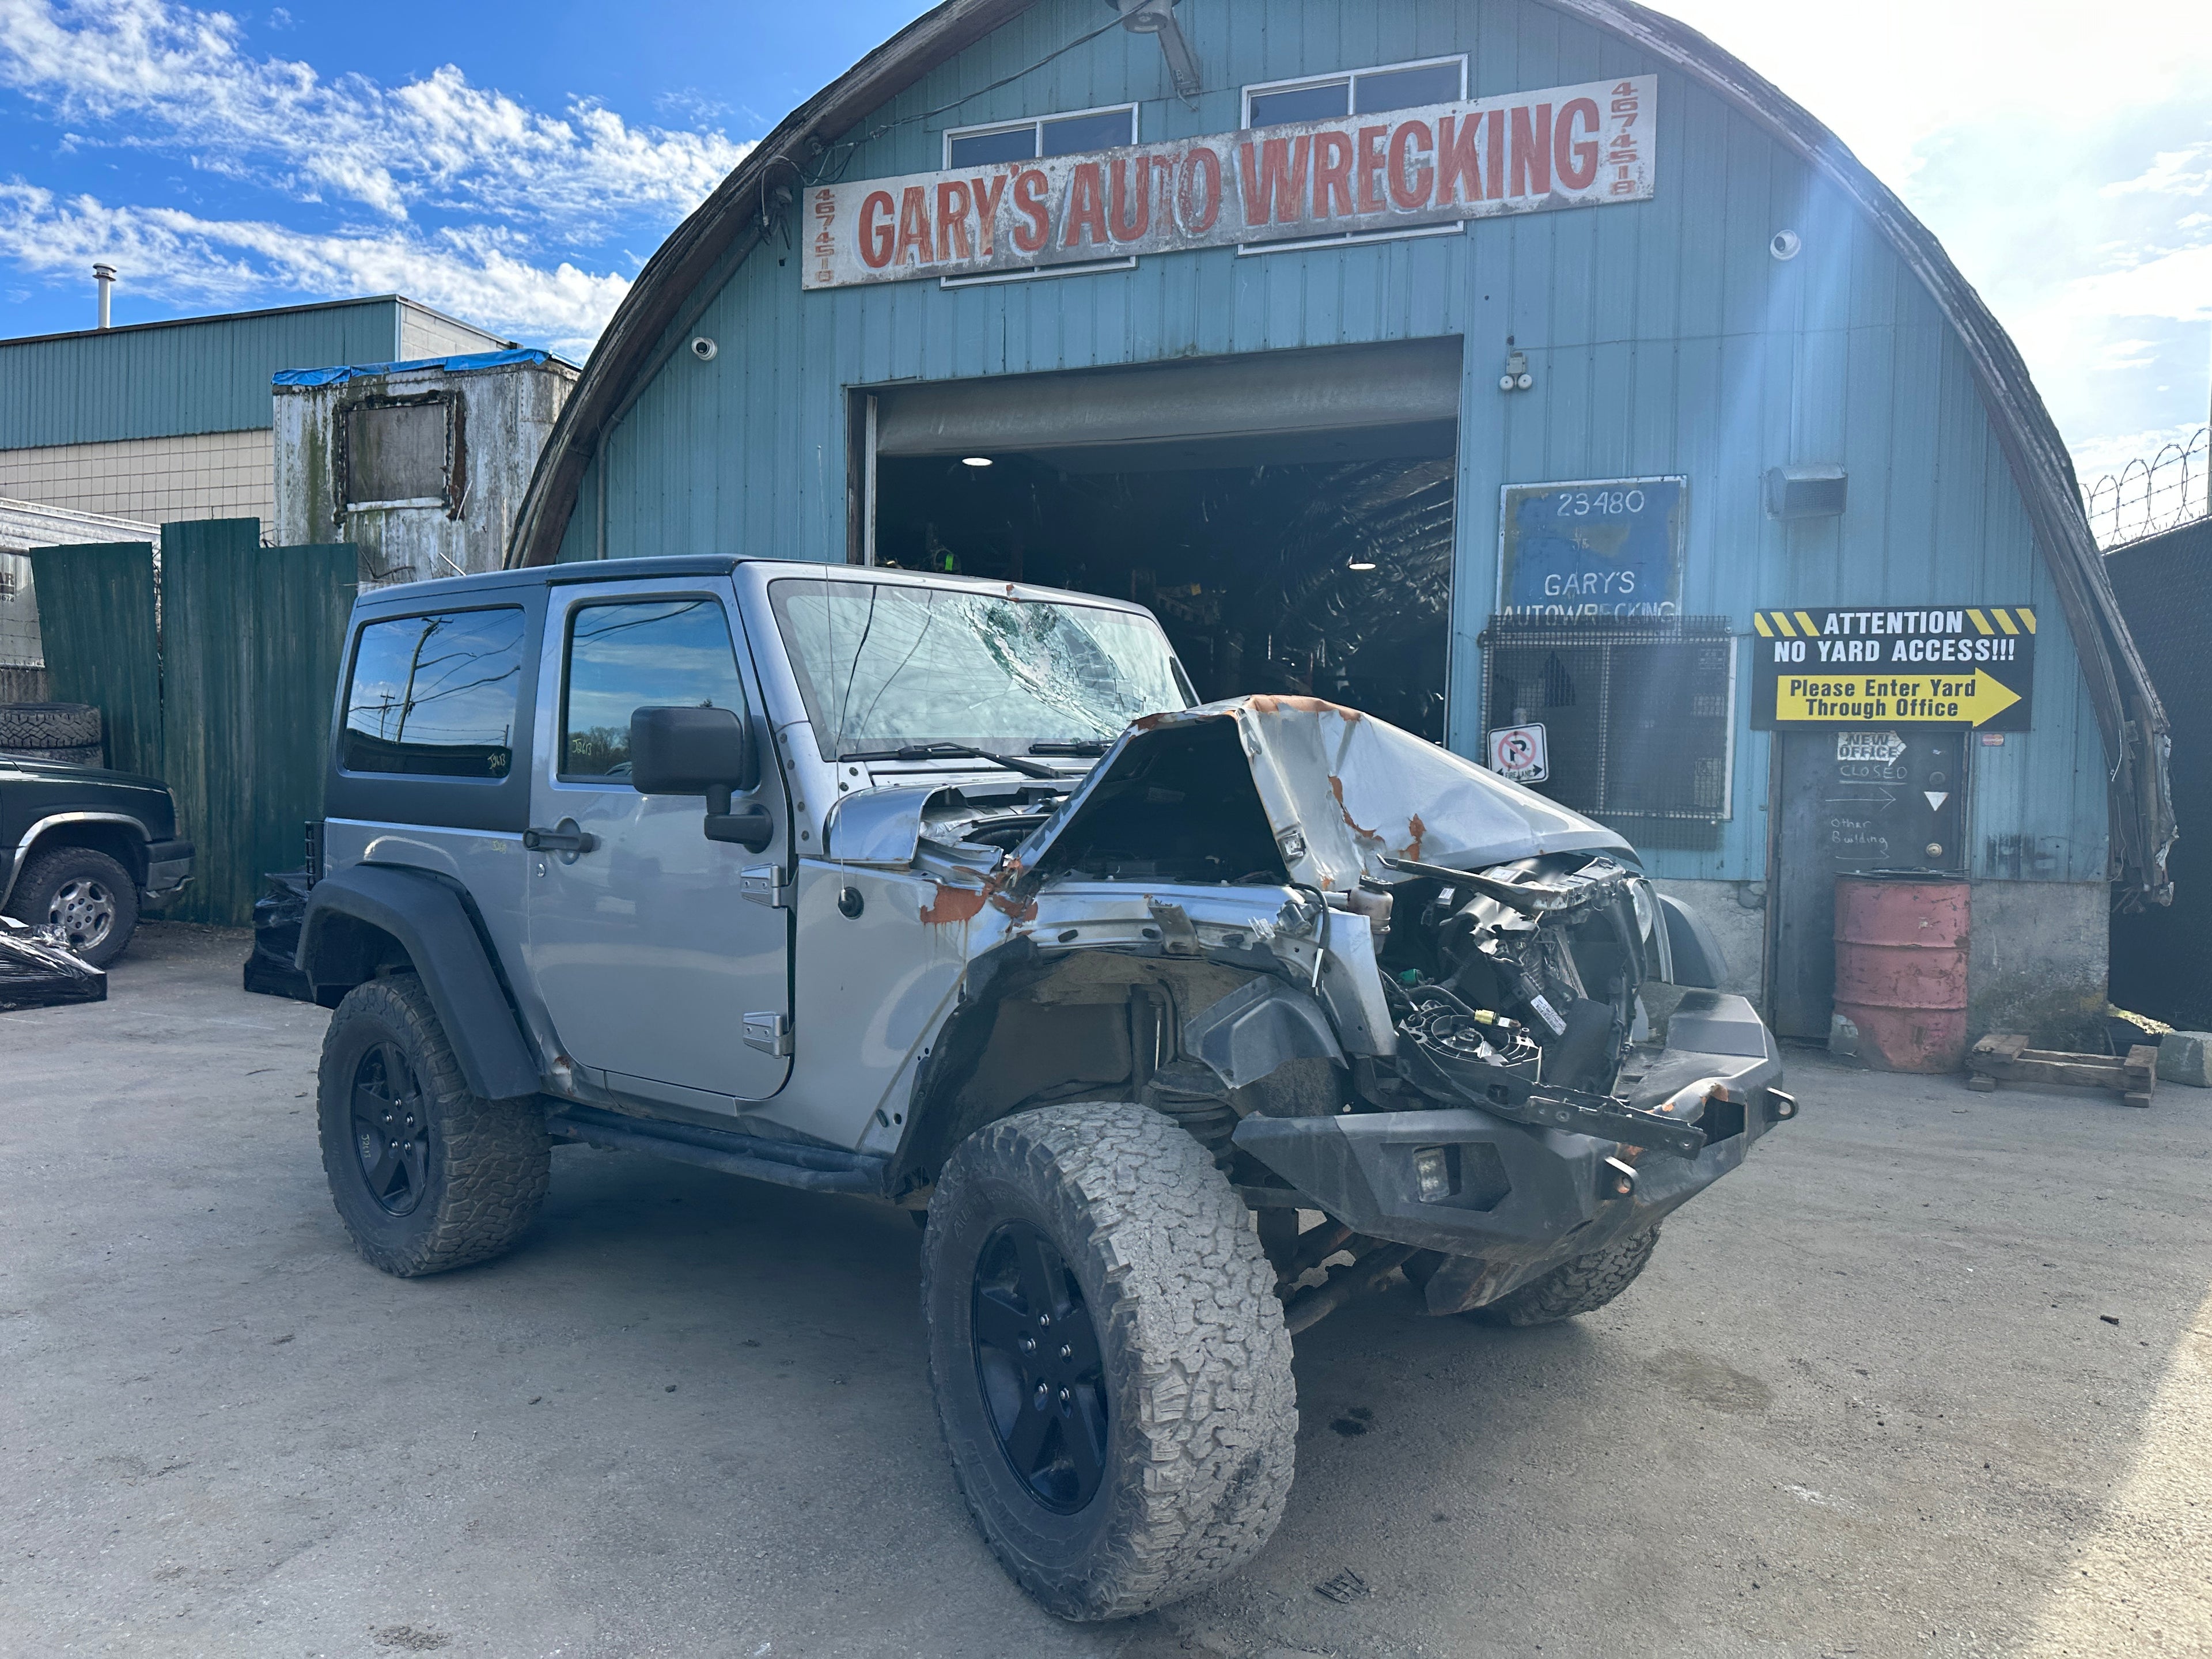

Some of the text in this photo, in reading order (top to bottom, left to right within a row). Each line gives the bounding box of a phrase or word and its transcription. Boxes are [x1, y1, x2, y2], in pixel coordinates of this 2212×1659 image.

[858, 97, 1601, 269] GARY'S AUTO WRECKING
[1557, 490, 1645, 516] 23480
[1544, 571, 1635, 596] GARY'S
[1823, 611, 1963, 634] ATTENTION
[1774, 638, 2015, 662] NO YARD ACCESS!!!
[1790, 679, 1975, 696] Please Enter Yard
[1806, 698, 1958, 719] Through Office
[1839, 744, 1898, 758] OFFICE
[1847, 733, 1889, 746] NEW
